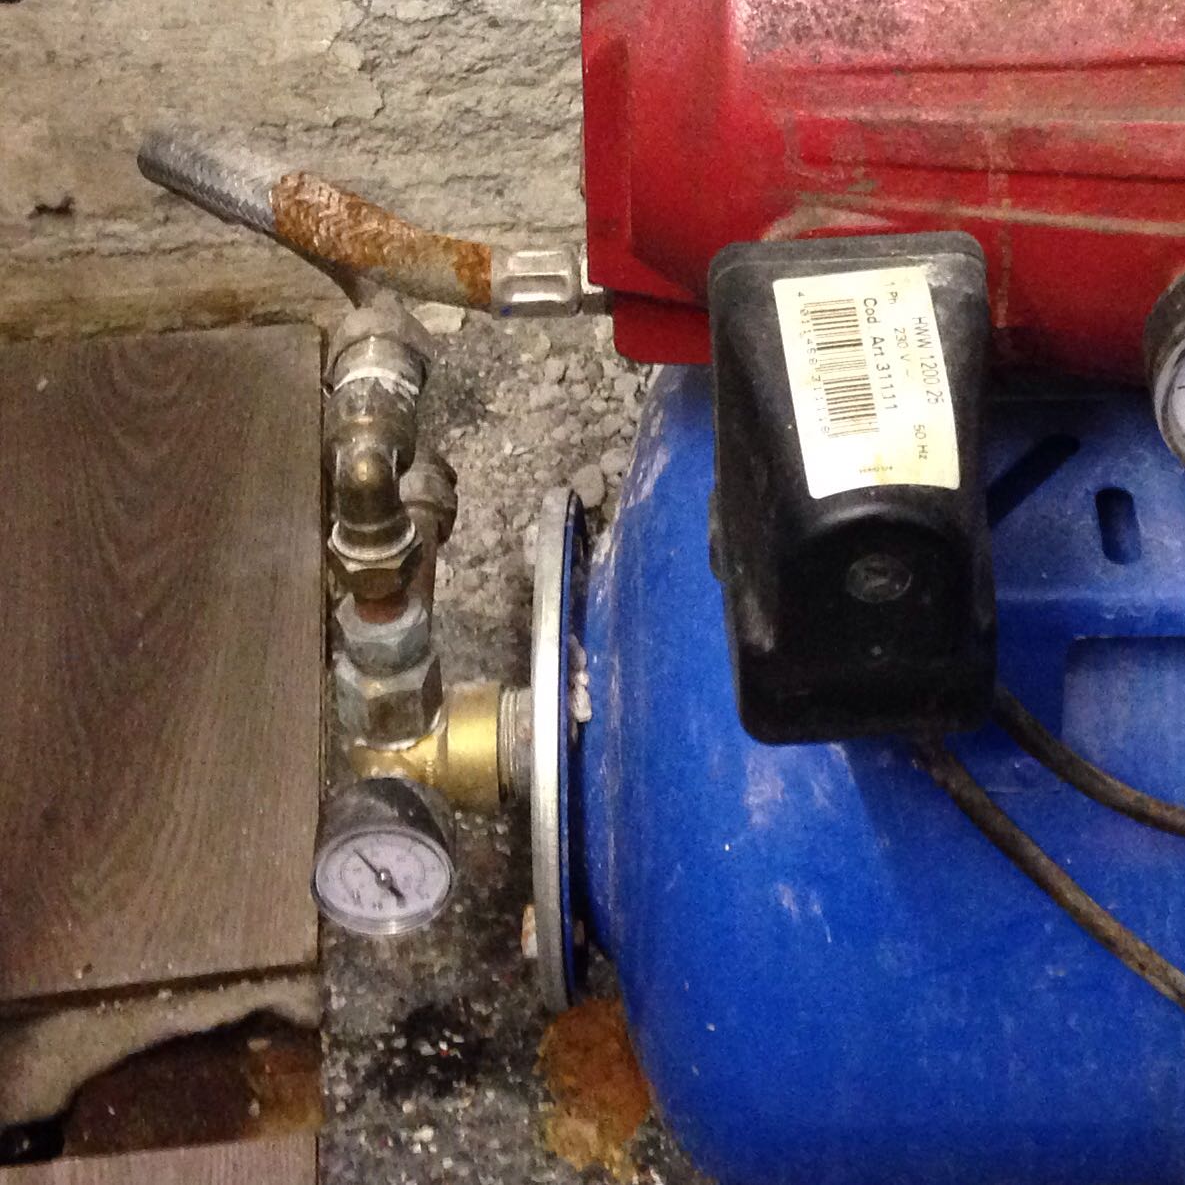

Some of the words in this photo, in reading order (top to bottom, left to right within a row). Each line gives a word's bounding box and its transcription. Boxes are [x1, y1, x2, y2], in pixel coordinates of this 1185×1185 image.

[894, 328, 909, 349] 230
[912, 316, 934, 348] HWW
[876, 364, 898, 410] 31111
[914, 424, 927, 440] 50
[917, 444, 929, 460] Hz
